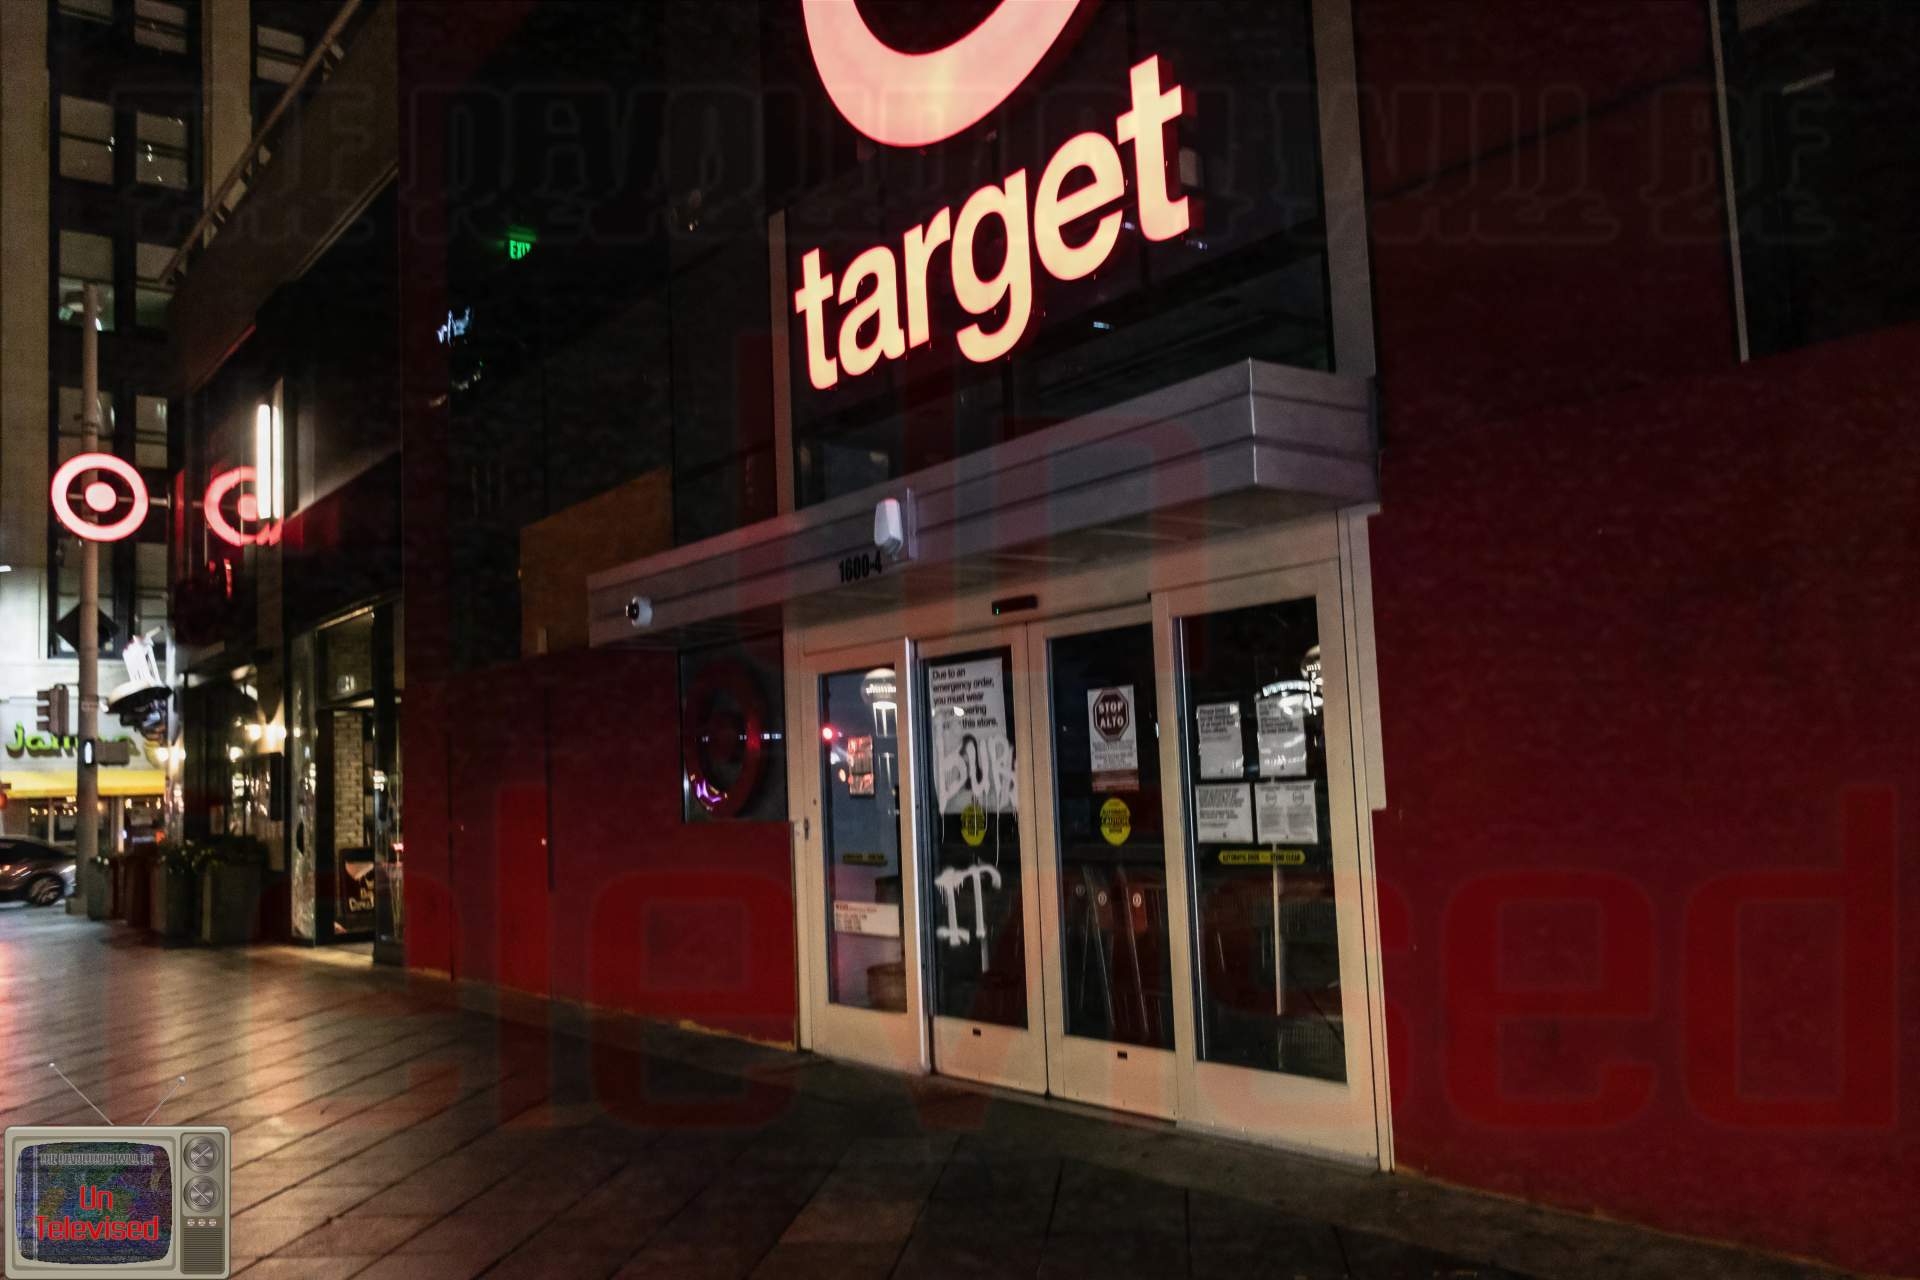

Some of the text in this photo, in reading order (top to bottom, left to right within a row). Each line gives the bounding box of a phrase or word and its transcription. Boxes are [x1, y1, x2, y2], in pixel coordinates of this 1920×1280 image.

[794, 54, 1191, 391] target
[509, 239, 532, 260] EXIT
[838, 549, 882, 583] 1600-4
[932, 668, 966, 679] Due to an
[932, 677, 995, 692] emergency order,
[933, 692, 984, 706] you must wear
[1098, 701, 1124, 714] STOP
[962, 717, 976, 729] this
[976, 718, 998, 728] store.
[1099, 715, 1125, 728] ALTO
[934, 864, 1001, 966] IT
